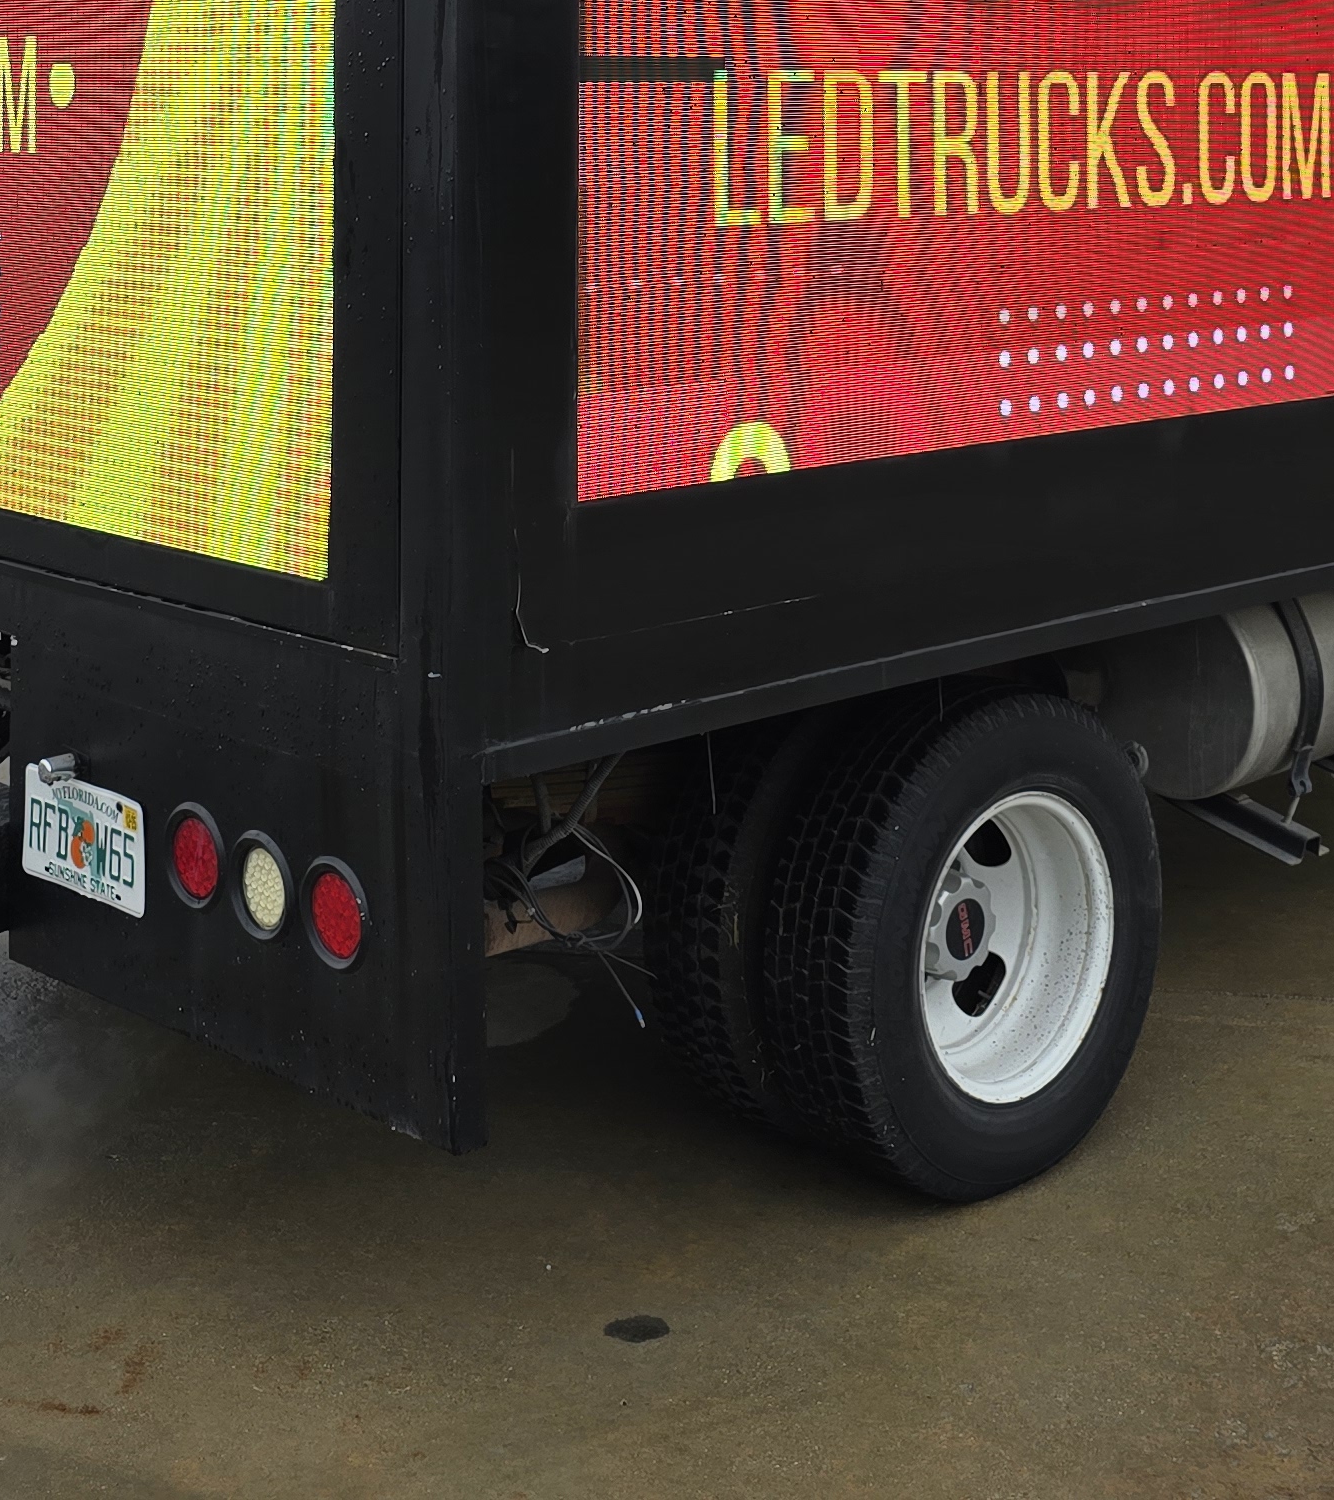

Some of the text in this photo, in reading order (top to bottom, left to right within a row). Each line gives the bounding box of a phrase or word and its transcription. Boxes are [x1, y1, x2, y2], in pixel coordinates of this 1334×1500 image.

[712, 67, 1333, 228] LEDTRUCKS.COM
[52, 786, 119, 823] MYFLORIDA.COM
[28, 796, 136, 889] RFB W65
[48, 860, 117, 901] SUNSHINE STATE
[957, 902, 974, 958] GMC
